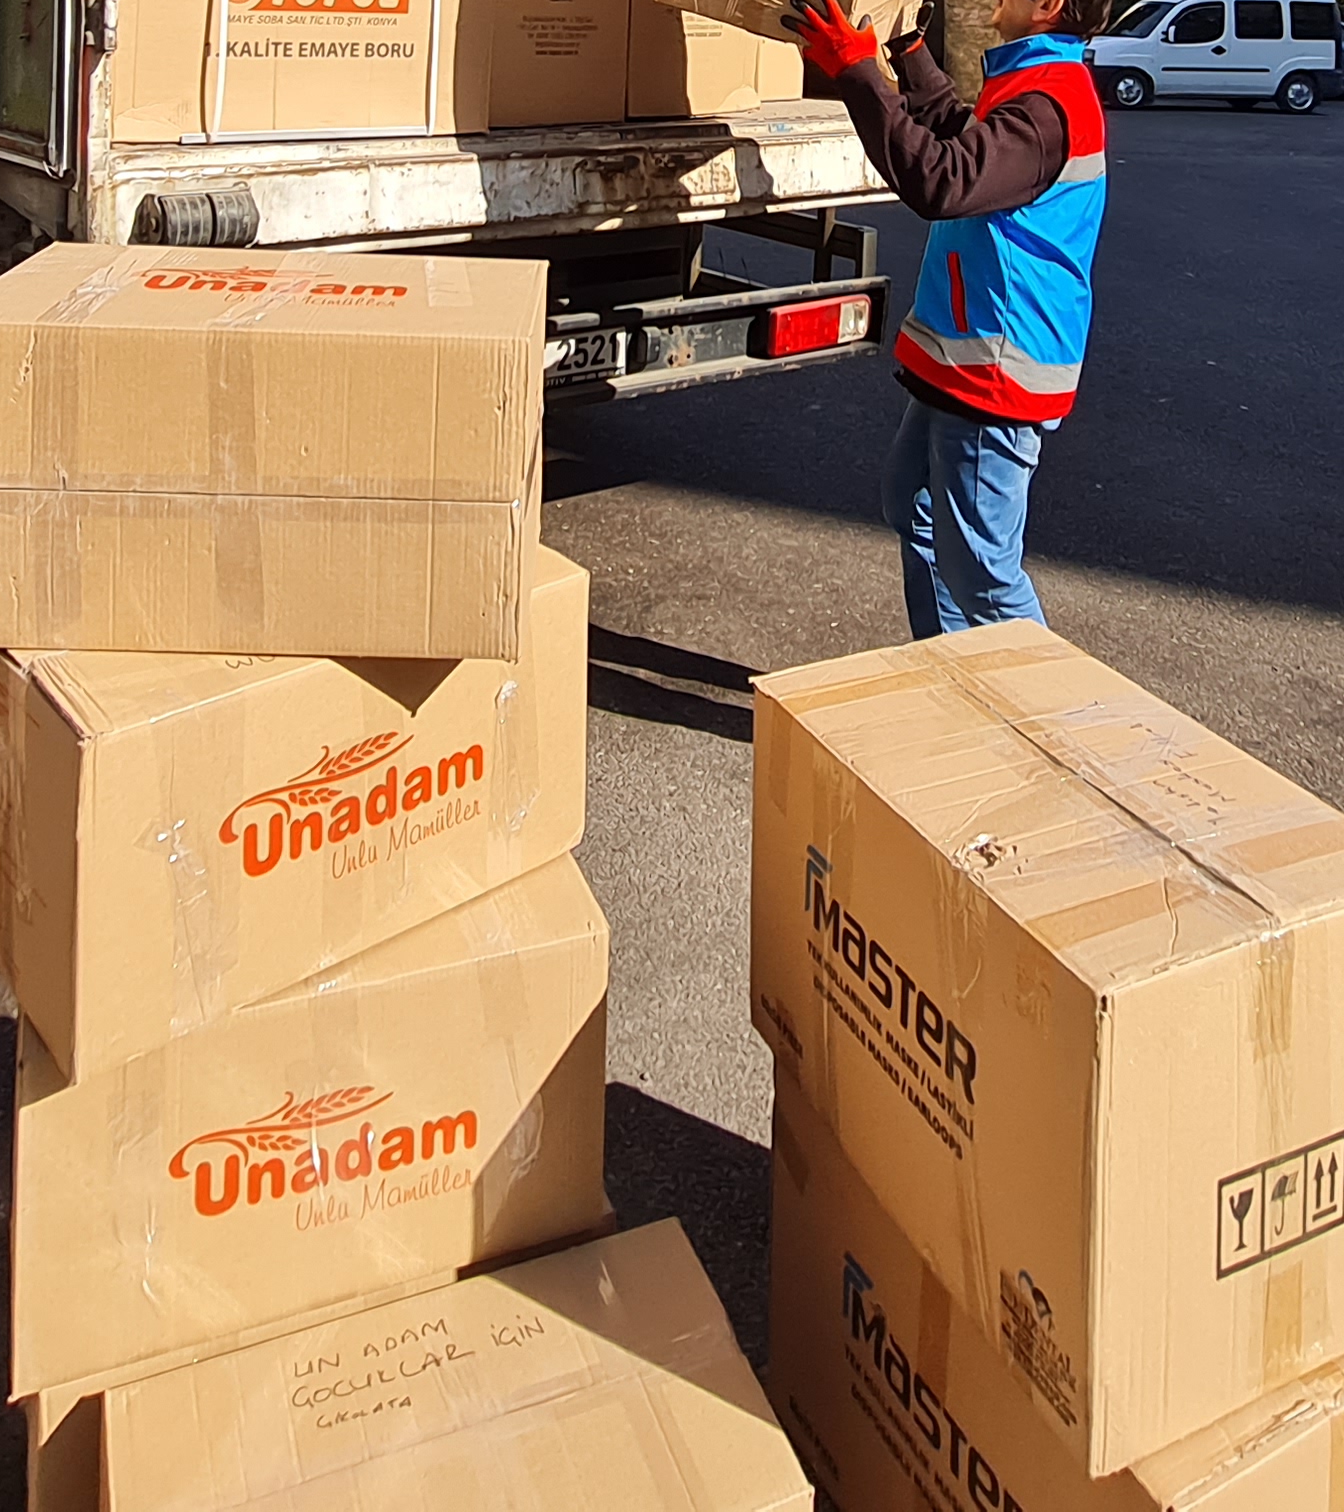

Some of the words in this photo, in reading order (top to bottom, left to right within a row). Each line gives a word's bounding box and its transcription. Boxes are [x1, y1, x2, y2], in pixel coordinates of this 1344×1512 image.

[227, 14, 254, 25] MAYE
[257, 15, 284, 25] SOBA
[366, 17, 399, 27] KONYA
[226, 38, 293, 58] KALİTE
[297, 42, 360, 58] EMAYE
[364, 43, 415, 59] BORU
[144, 274, 408, 297] Unadam
[556, 334, 618, 372] 2521
[242, 743, 484, 878] Unadam
[331, 846, 378, 880] Unlu
[386, 798, 482, 862] Mamüller
[806, 938, 824, 968] TEK
[885, 1030, 920, 1080] MASKE
[867, 1038, 900, 1087] MASKS
[907, 1085, 963, 1161] EARLOOPS
[193, 1109, 479, 1217] Unadam
[294, 1194, 350, 1232] Unlu
[363, 1319, 448, 1358] ADAM
